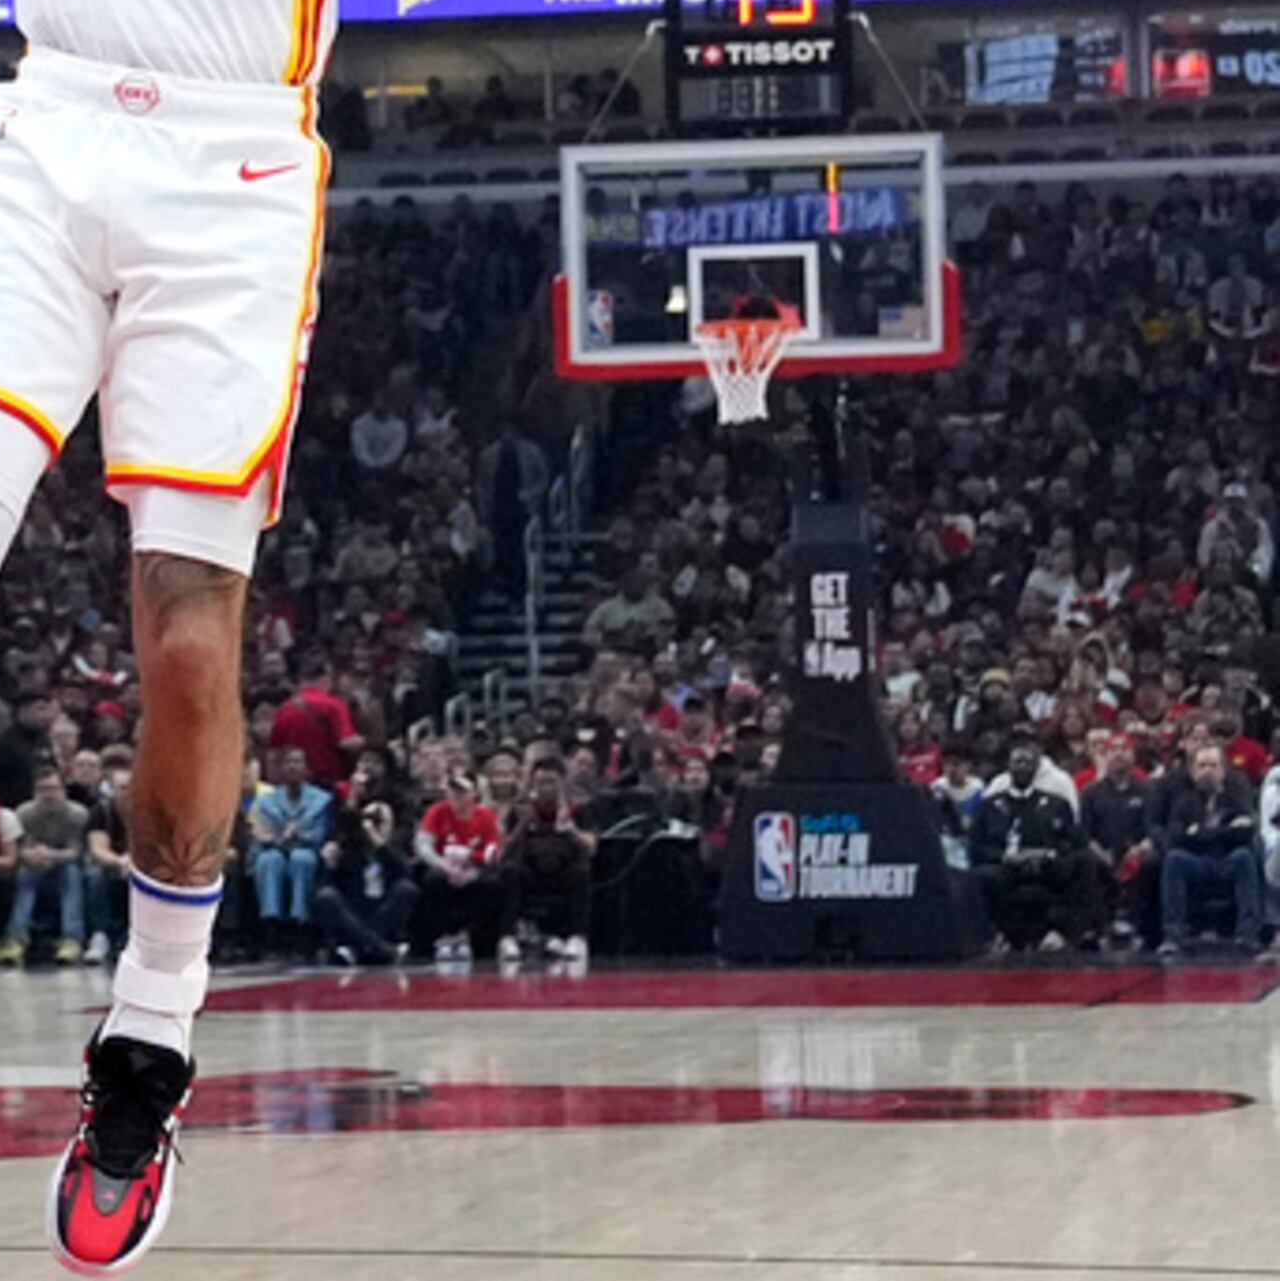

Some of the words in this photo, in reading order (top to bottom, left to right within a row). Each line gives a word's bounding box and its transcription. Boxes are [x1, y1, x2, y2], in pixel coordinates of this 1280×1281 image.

[725, 40, 834, 65] TISSOT
[810, 571, 849, 606] GET
[810, 607, 851, 639] THE
